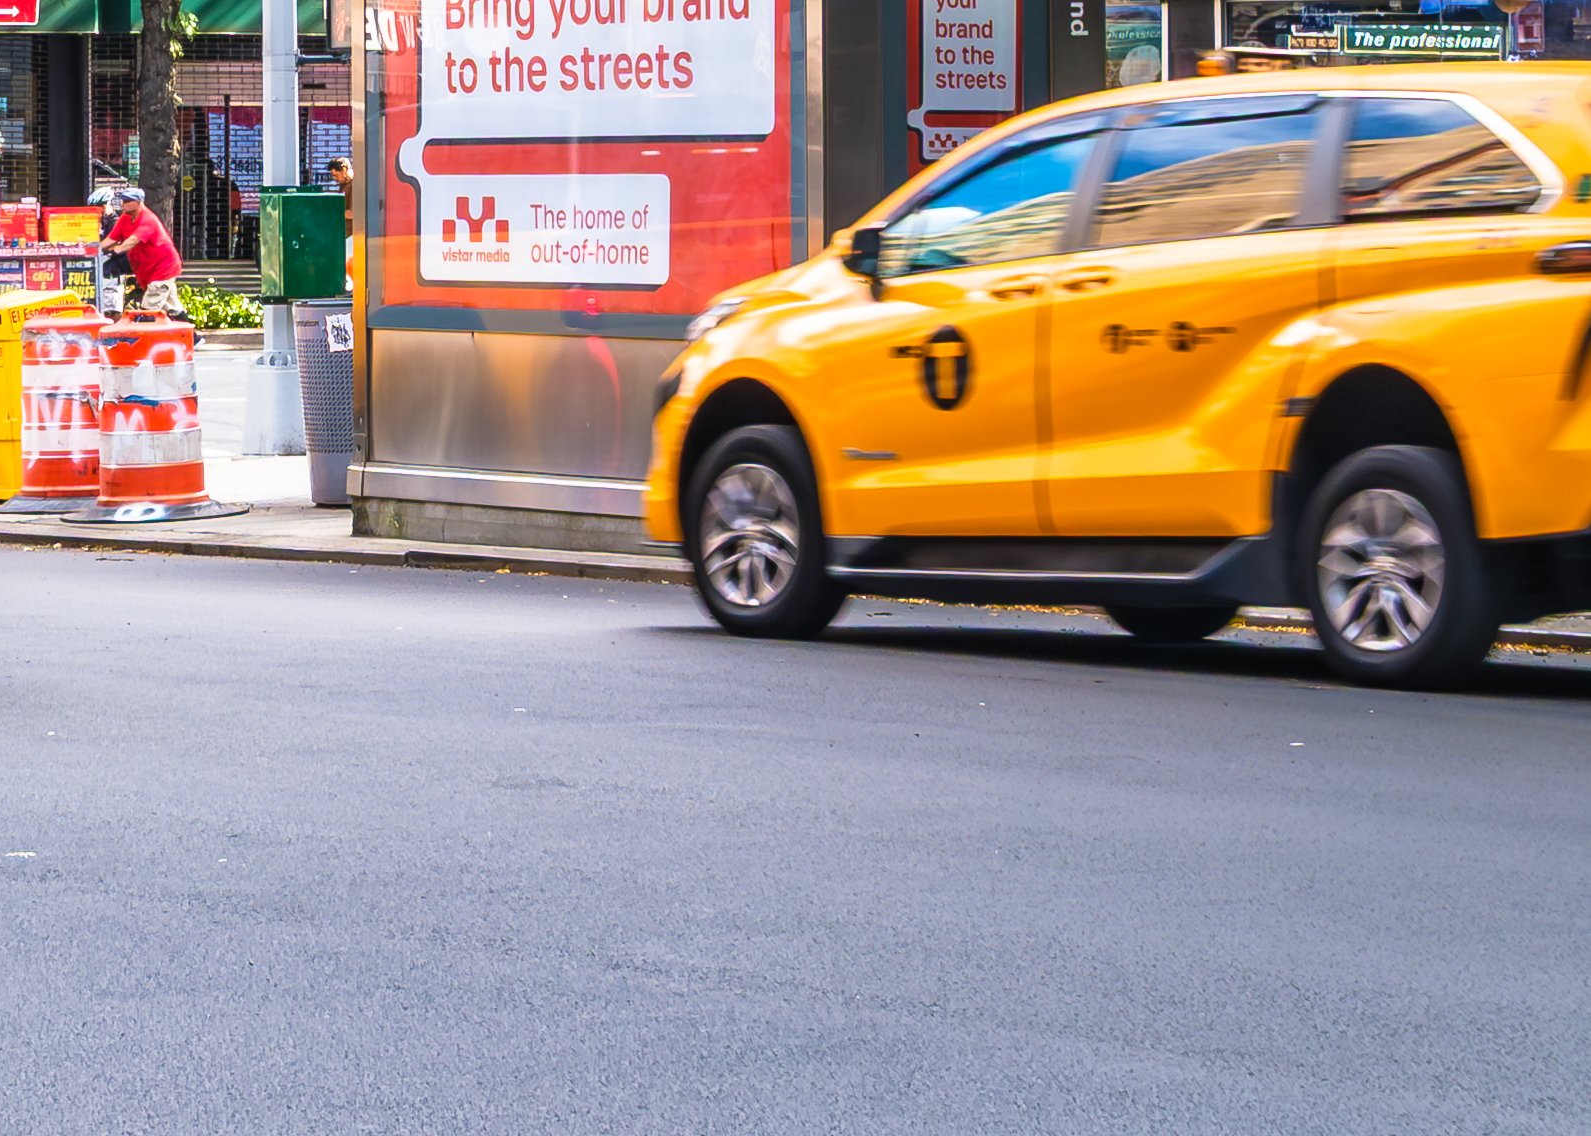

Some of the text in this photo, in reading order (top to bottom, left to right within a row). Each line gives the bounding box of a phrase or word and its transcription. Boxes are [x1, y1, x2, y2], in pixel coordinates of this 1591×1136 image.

[934, 18, 993, 39] brand
[1354, 31, 1385, 46] The
[1388, 32, 1501, 50] professional
[934, 45, 995, 65] to the
[445, 44, 694, 94] to the streets
[934, 70, 1007, 90] streets
[530, 203, 649, 230] The home of
[442, 247, 510, 262] vistar media
[531, 238, 649, 265] out-of-home
[68, 271, 90, 285] FULL
